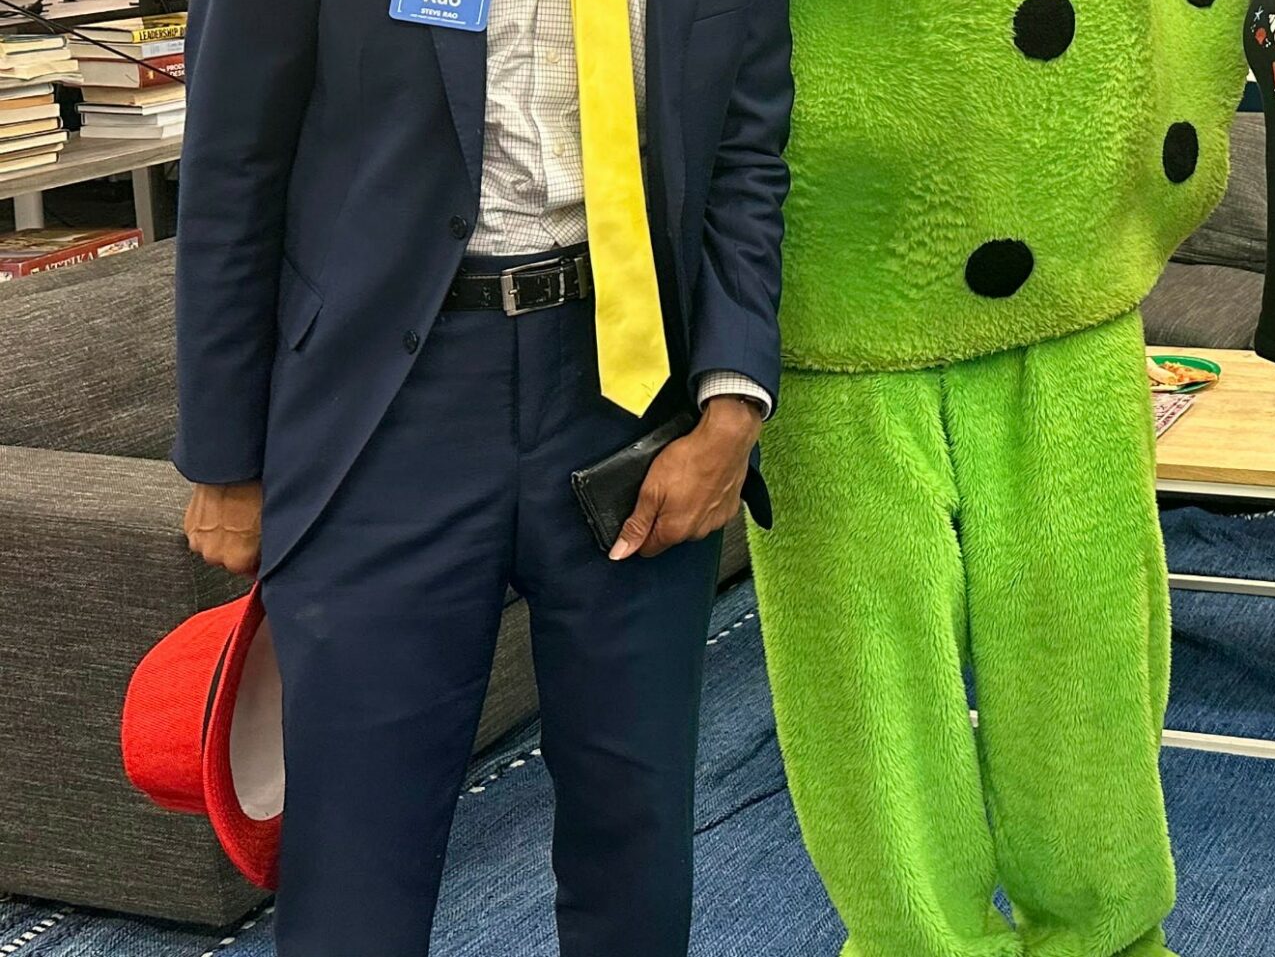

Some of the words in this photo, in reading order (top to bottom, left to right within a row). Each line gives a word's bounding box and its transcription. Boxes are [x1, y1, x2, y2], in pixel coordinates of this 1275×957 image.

[420, 7, 441, 17] STEVE
[442, 11, 459, 19] RAO
[138, 27, 179, 41] LEADERSHIP
